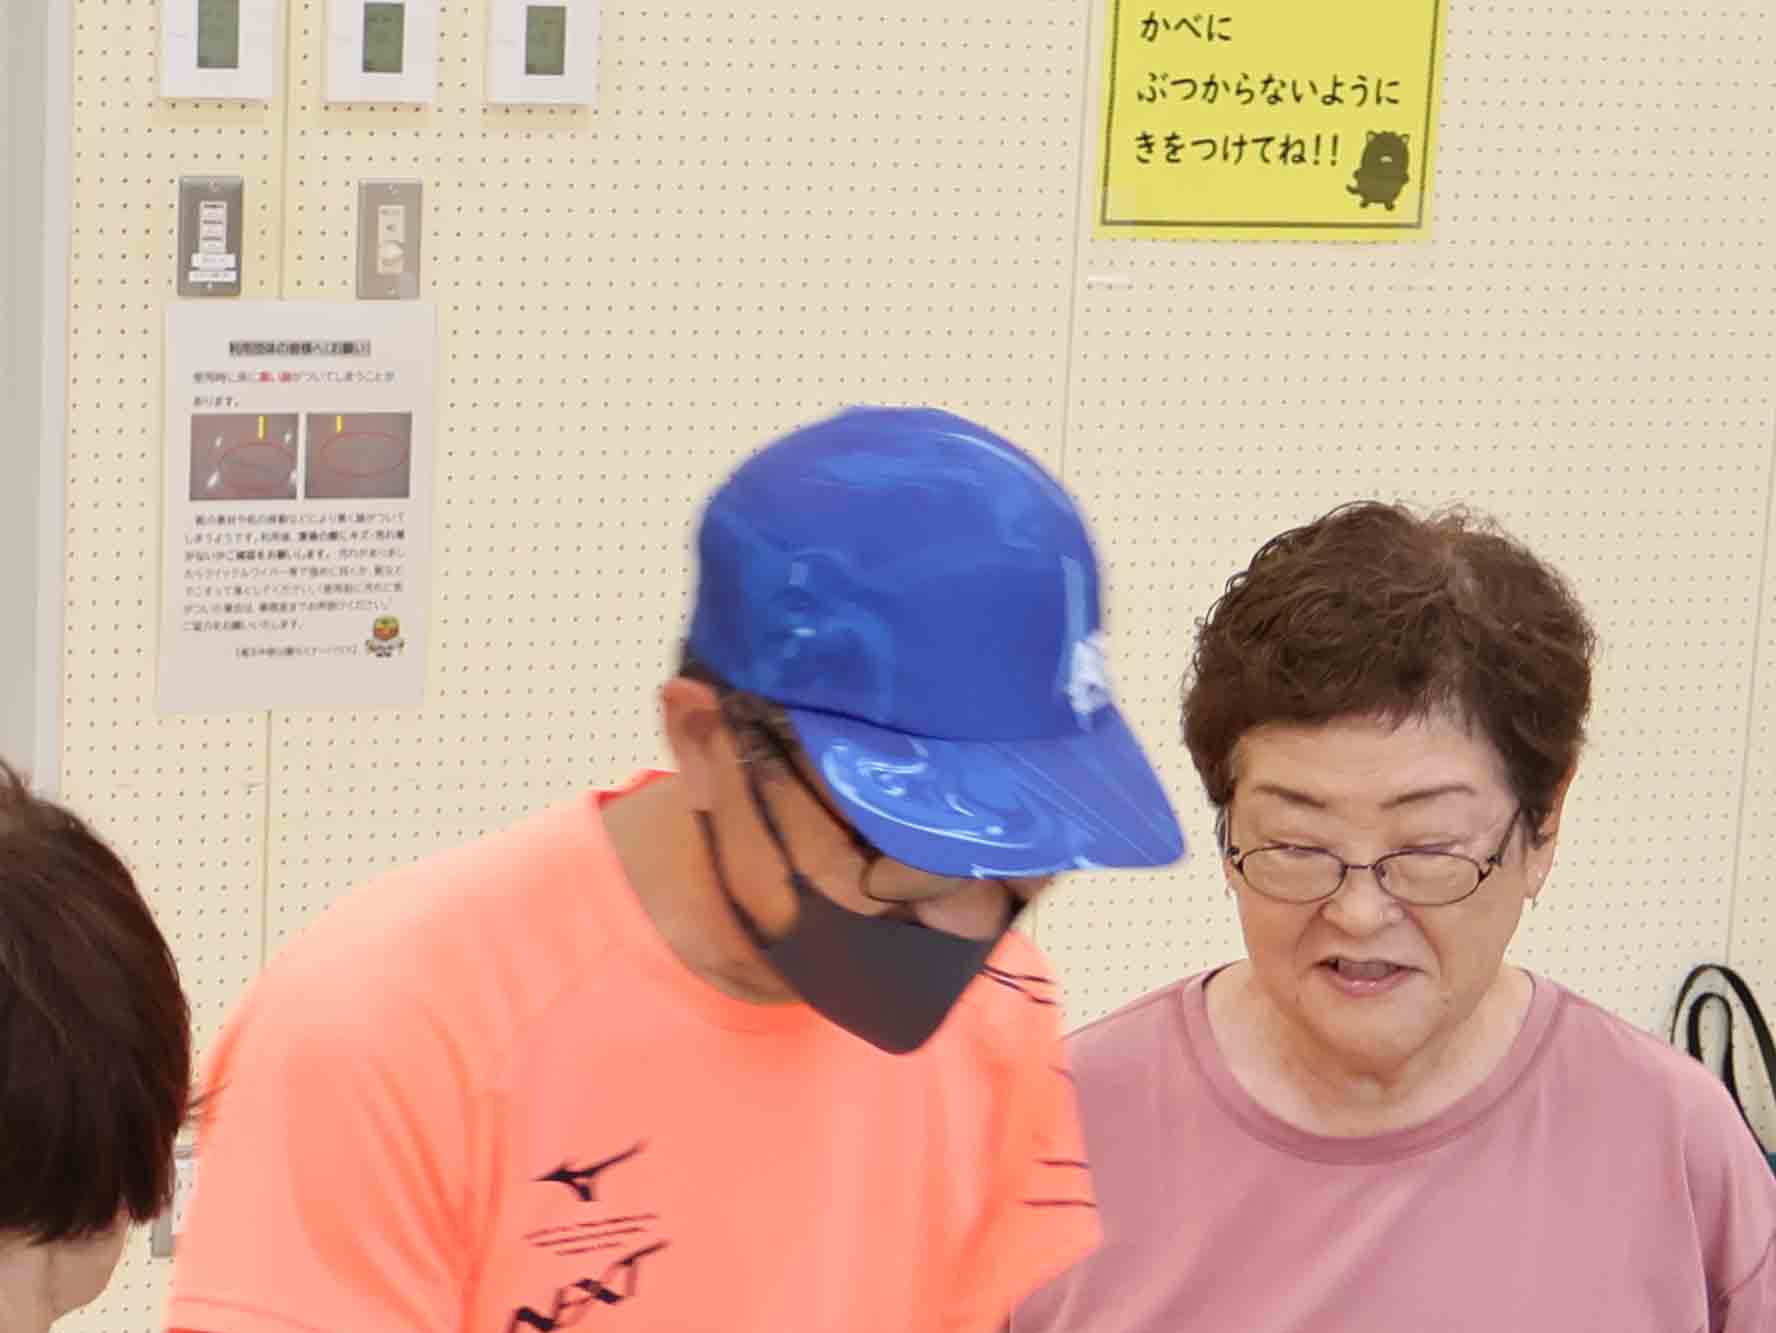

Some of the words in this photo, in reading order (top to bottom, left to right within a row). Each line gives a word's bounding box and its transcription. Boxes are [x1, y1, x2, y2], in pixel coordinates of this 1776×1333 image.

[1140, 11, 1233, 42] かべに
[1136, 72, 1401, 108] ぶつからないように
[1135, 130, 1339, 166] きをつけてね!!
